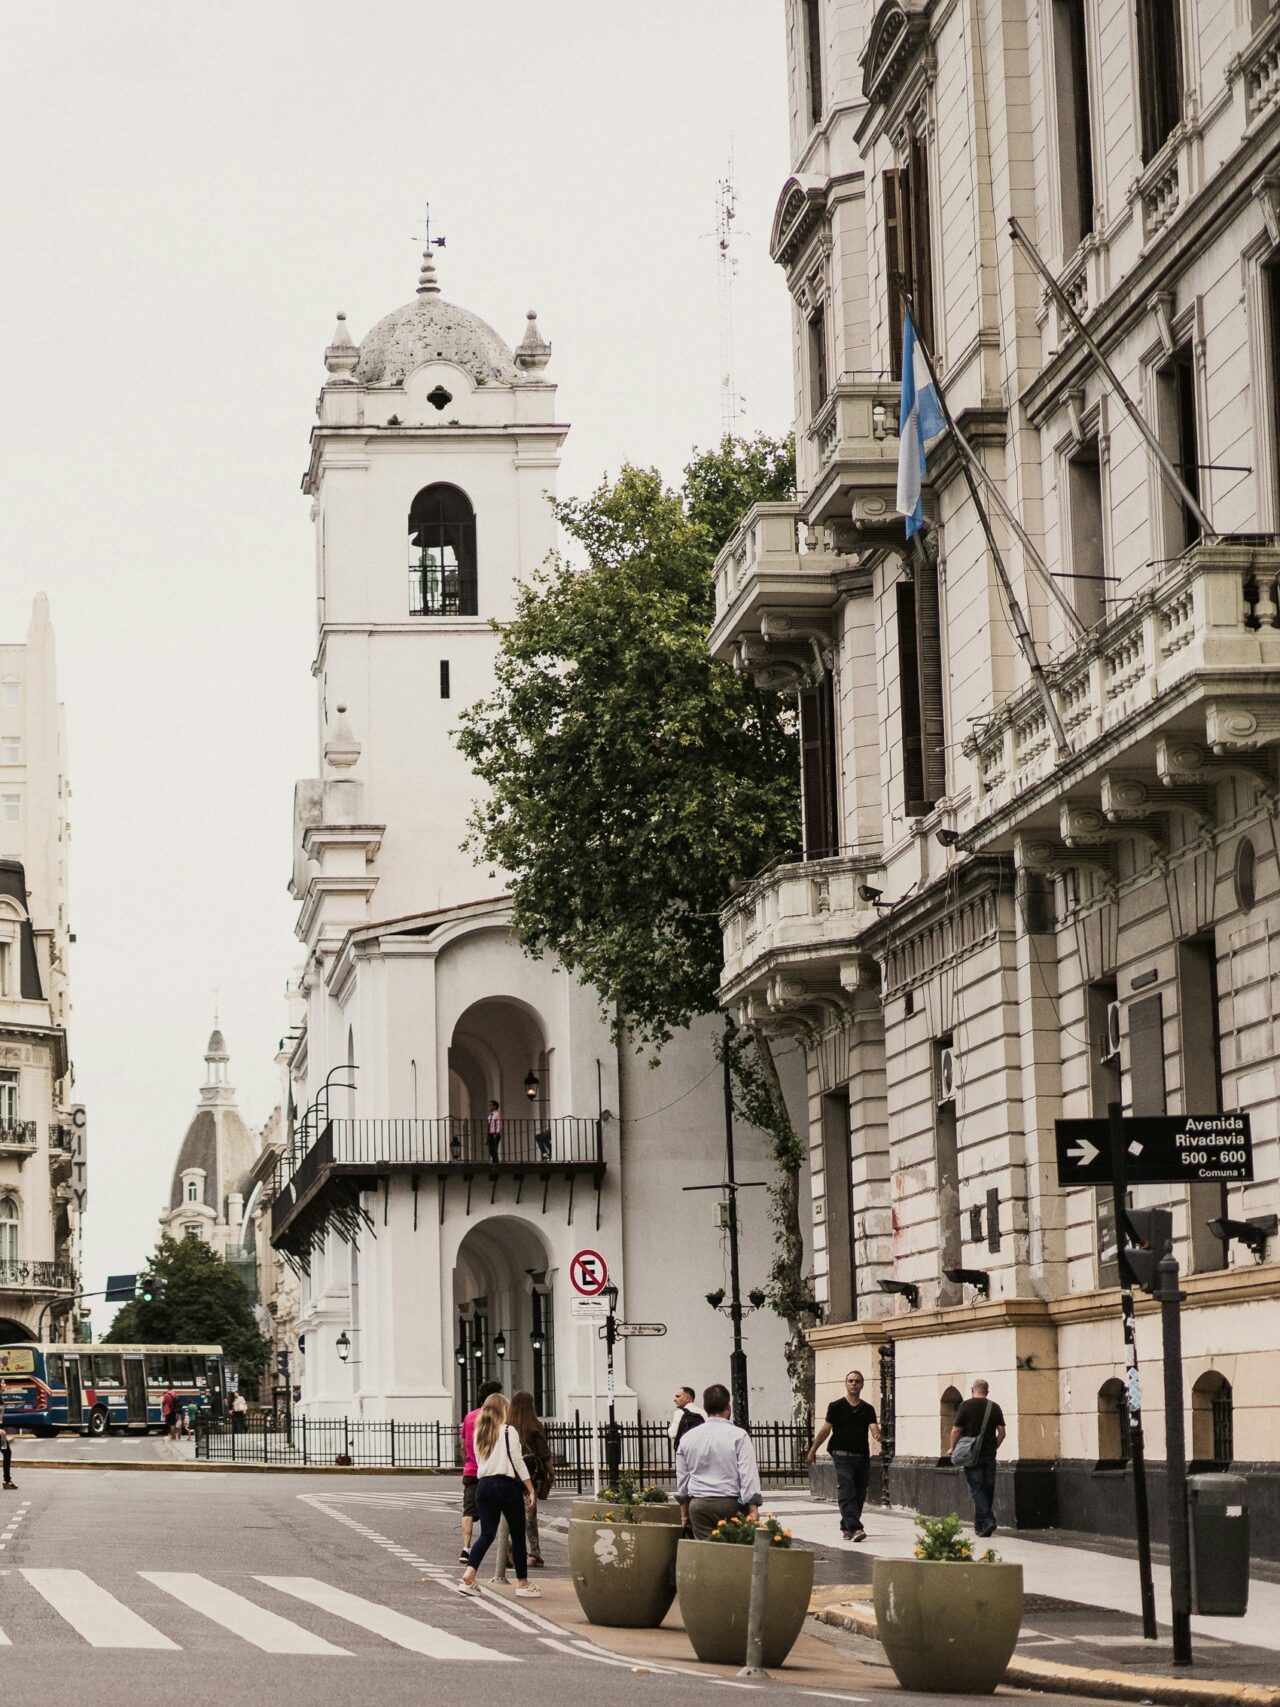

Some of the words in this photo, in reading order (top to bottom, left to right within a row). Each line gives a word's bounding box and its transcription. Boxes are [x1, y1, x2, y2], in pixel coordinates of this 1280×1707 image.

[1185, 1117, 1243, 1131] Avenida
[1175, 1133, 1245, 1147] Rivadavia
[73, 1108, 86, 1209] CITY
[1181, 1152, 1207, 1164] 500
[1220, 1150, 1246, 1163] 600
[1198, 1168, 1238, 1177] Comuna
[1241, 1168, 1246, 1177] 1
[581, 1260, 597, 1286] E
